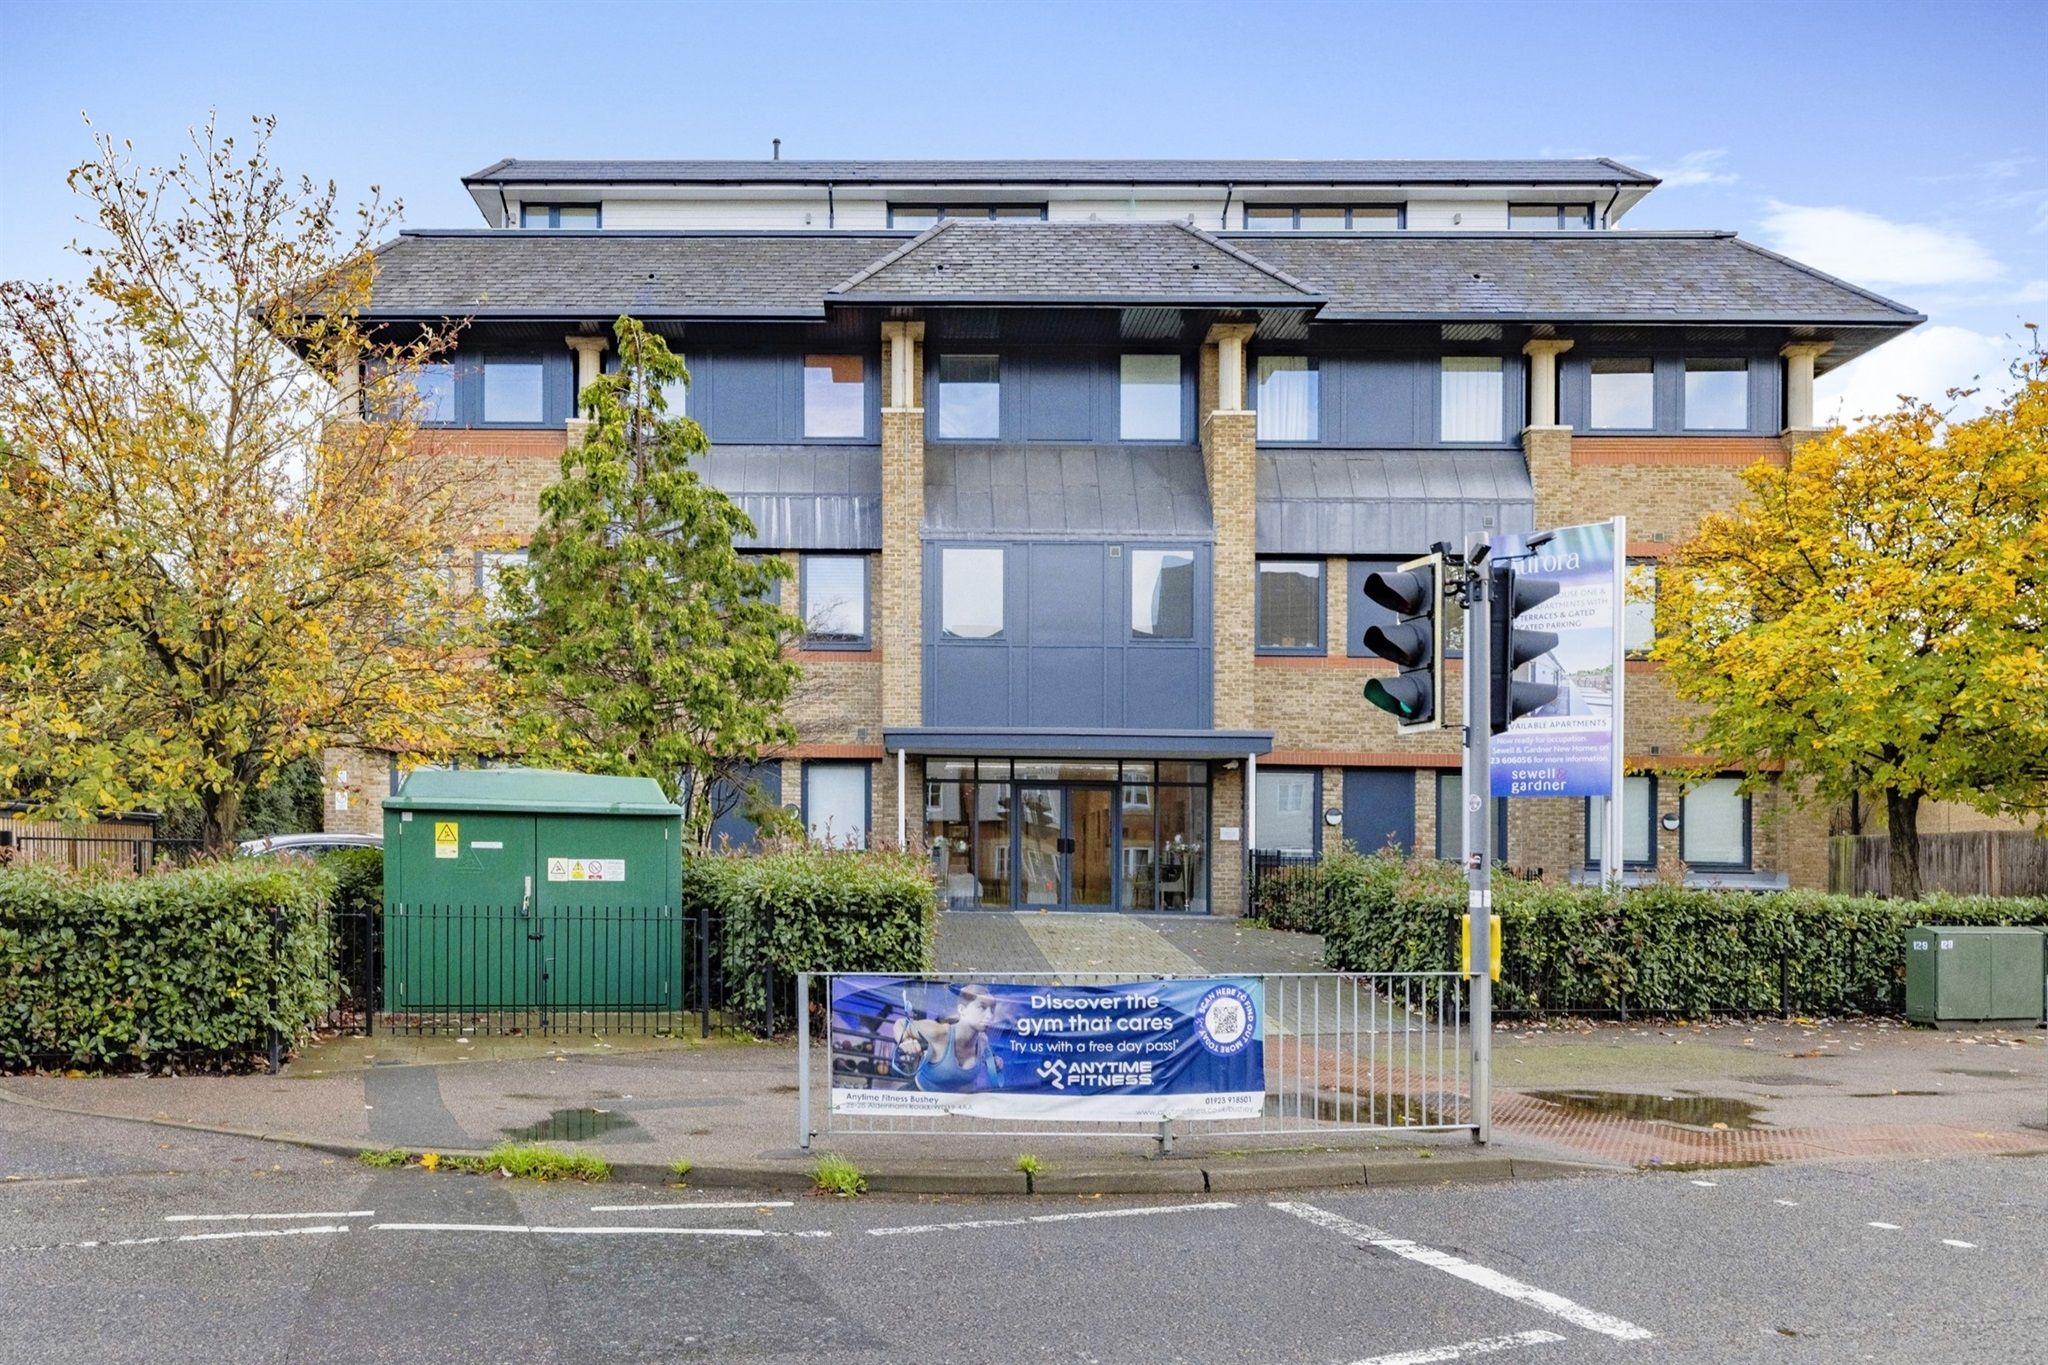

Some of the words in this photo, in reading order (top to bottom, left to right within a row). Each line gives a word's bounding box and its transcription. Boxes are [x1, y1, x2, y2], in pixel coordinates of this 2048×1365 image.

[1588, 598, 1608, 606] WITH
[1520, 612, 1558, 621] TERRACES
[1568, 609, 1596, 617] GATED
[1546, 620, 1581, 629] PARKING
[1510, 721, 1546, 730] VAILABLE
[1549, 719, 1607, 729] APARTMENTS
[1514, 737, 1534, 745] ready
[1501, 756, 1532, 764] 606056
[1511, 768, 1556, 780] sewell
[1511, 780, 1567, 794] gardner
[1216, 987, 1236, 997] HERE
[1236, 991, 1247, 1001] TO
[1031, 994, 1121, 1010] Discover
[1125, 993, 1159, 1009] the
[1198, 992, 1215, 1013] SCAN
[1244, 1000, 1254, 1022] FIND
[1017, 1017, 1063, 1036] gym
[1068, 1014, 1112, 1032] that
[1116, 1016, 1173, 1031] cares
[1242, 1024, 1253, 1043] OUT
[1010, 1040, 1026, 1054] Try
[1030, 1042, 1044, 1051] us
[1046, 1041, 1073, 1052] with
[1076, 1043, 1086, 1052] a
[1088, 1041, 1114, 1052] free
[1116, 1040, 1143, 1053] day
[1198, 1030, 1219, 1052] TODAY
[1220, 1040, 1243, 1054] MORE
[1068, 1061, 1152, 1074] ANYTIME
[1067, 1074, 1152, 1086] FITNESS
[846, 1093, 879, 1102] Anytime
[882, 1094, 908, 1102] Fitness
[910, 1095, 939, 1104] Bushey
